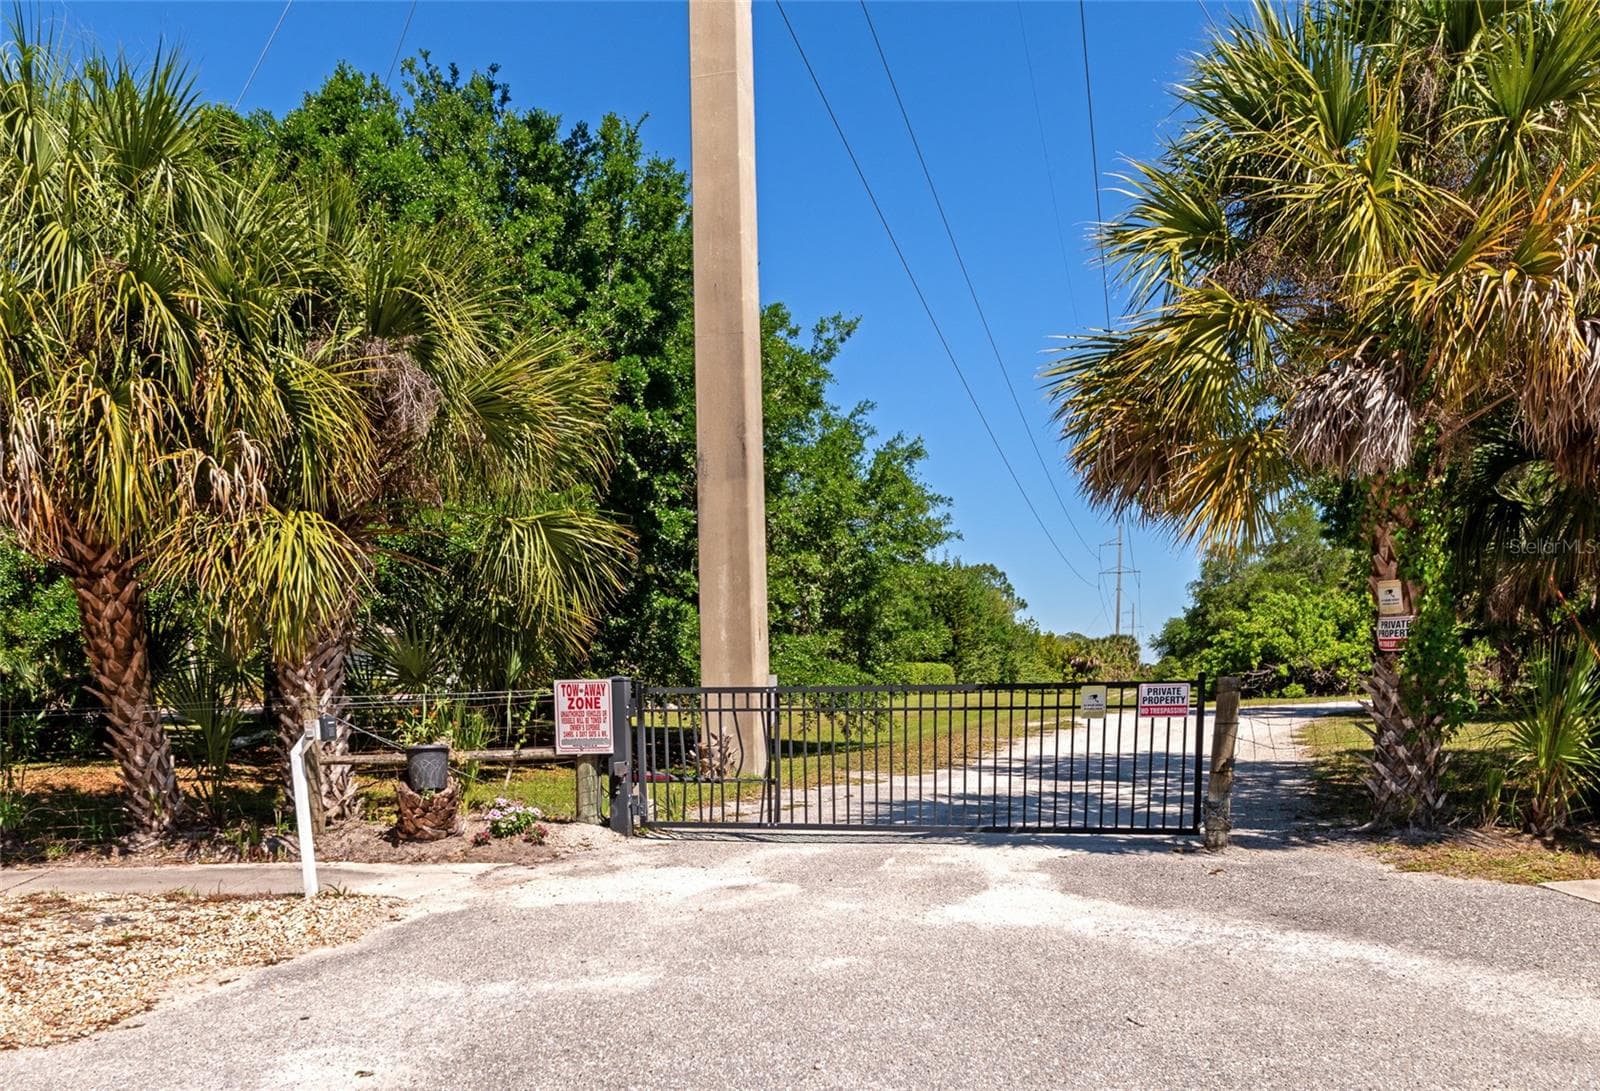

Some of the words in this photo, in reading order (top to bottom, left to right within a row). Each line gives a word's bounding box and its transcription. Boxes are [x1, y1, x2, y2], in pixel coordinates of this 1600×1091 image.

[1378, 629, 1409, 638] PROPERT
[561, 684, 606, 696] TOW-AWAY
[1147, 687, 1182, 696] PRIVATE
[568, 697, 601, 709] ZONE
[1142, 695, 1186, 704] PROPERTY
